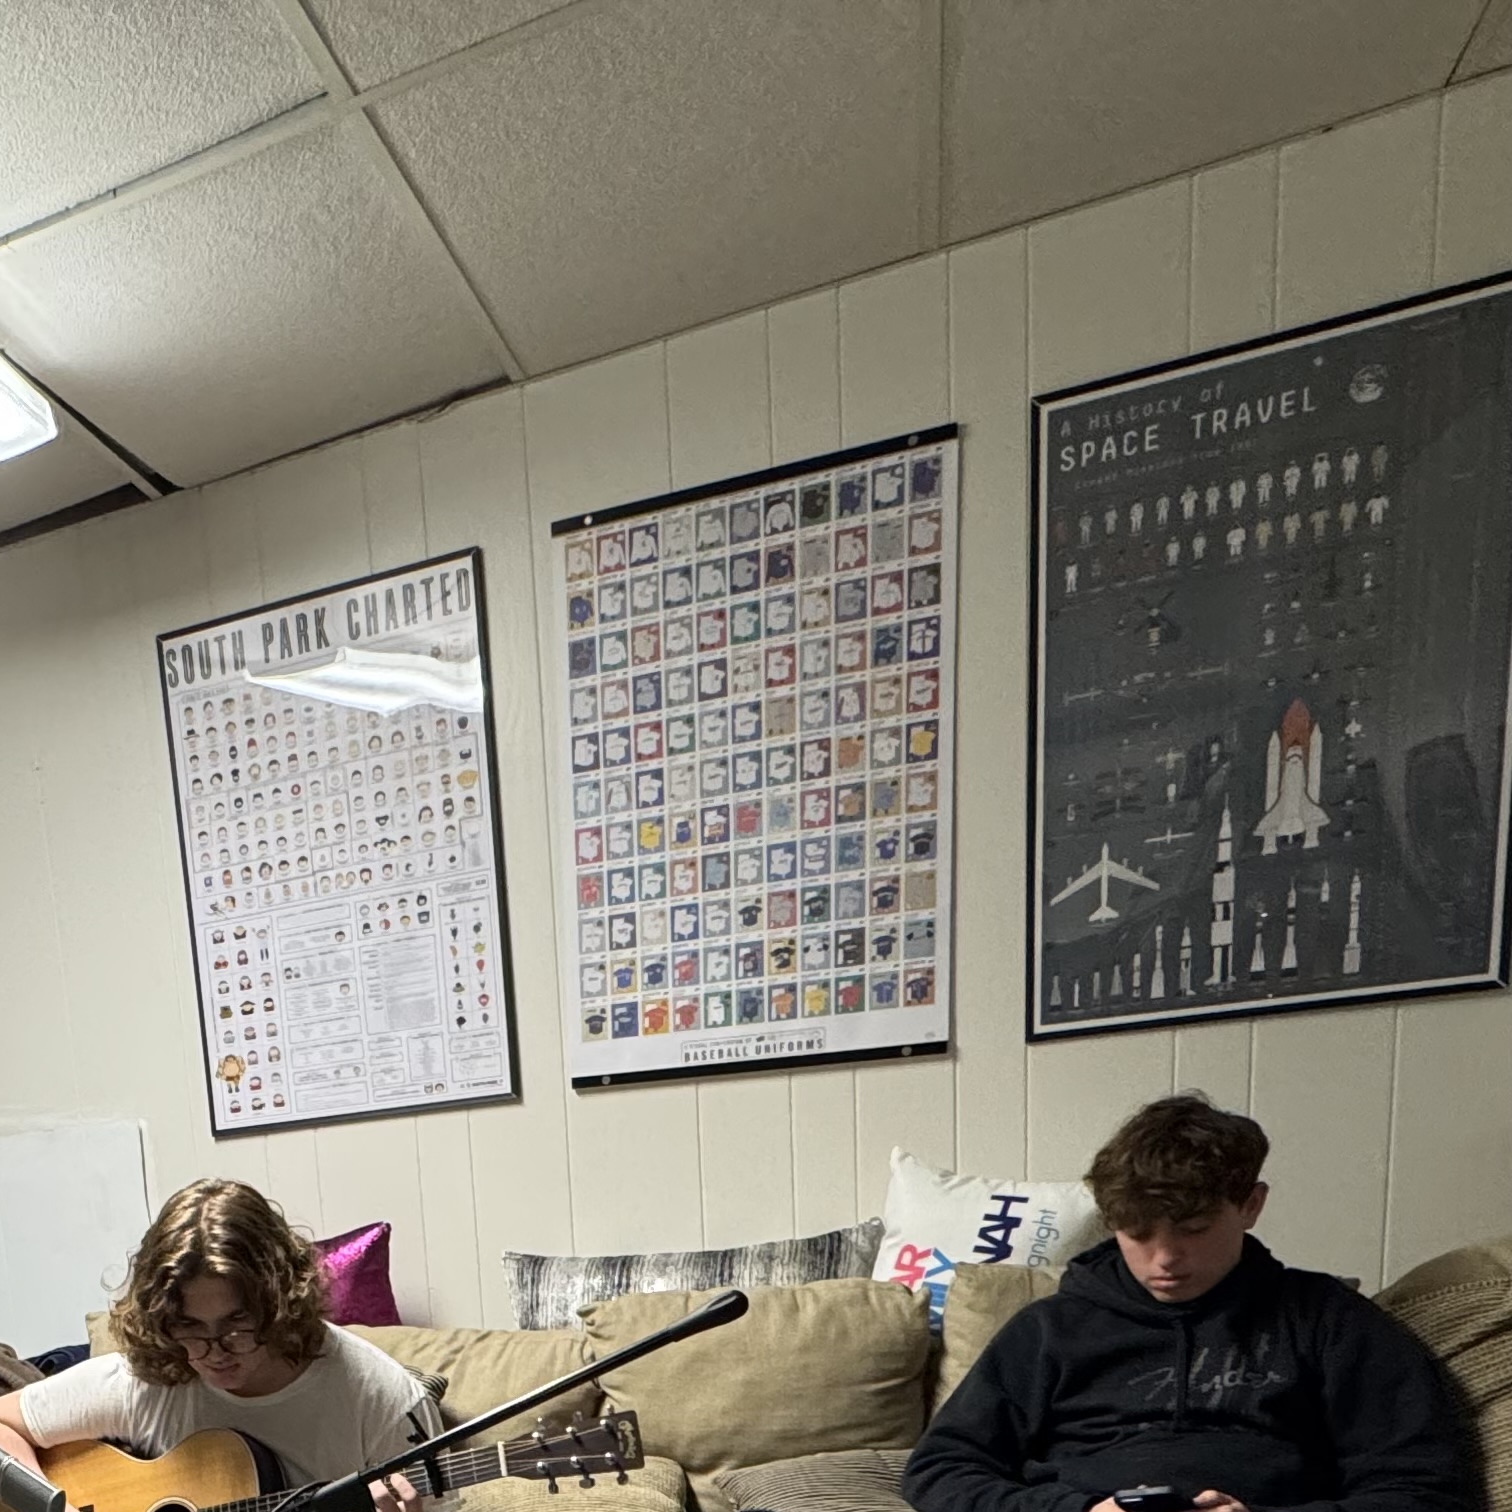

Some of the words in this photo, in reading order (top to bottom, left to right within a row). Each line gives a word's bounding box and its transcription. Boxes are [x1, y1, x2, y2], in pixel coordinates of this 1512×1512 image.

[1059, 424, 1160, 472] SPACE
[1191, 386, 1317, 440] TRAVEL
[165, 629, 247, 688] SOUTH
[261, 606, 330, 664] PARK
[346, 567, 472, 641] CHARTED
[684, 1045, 749, 1063] BASEBALL
[755, 1038, 824, 1056] UNIFORMS
